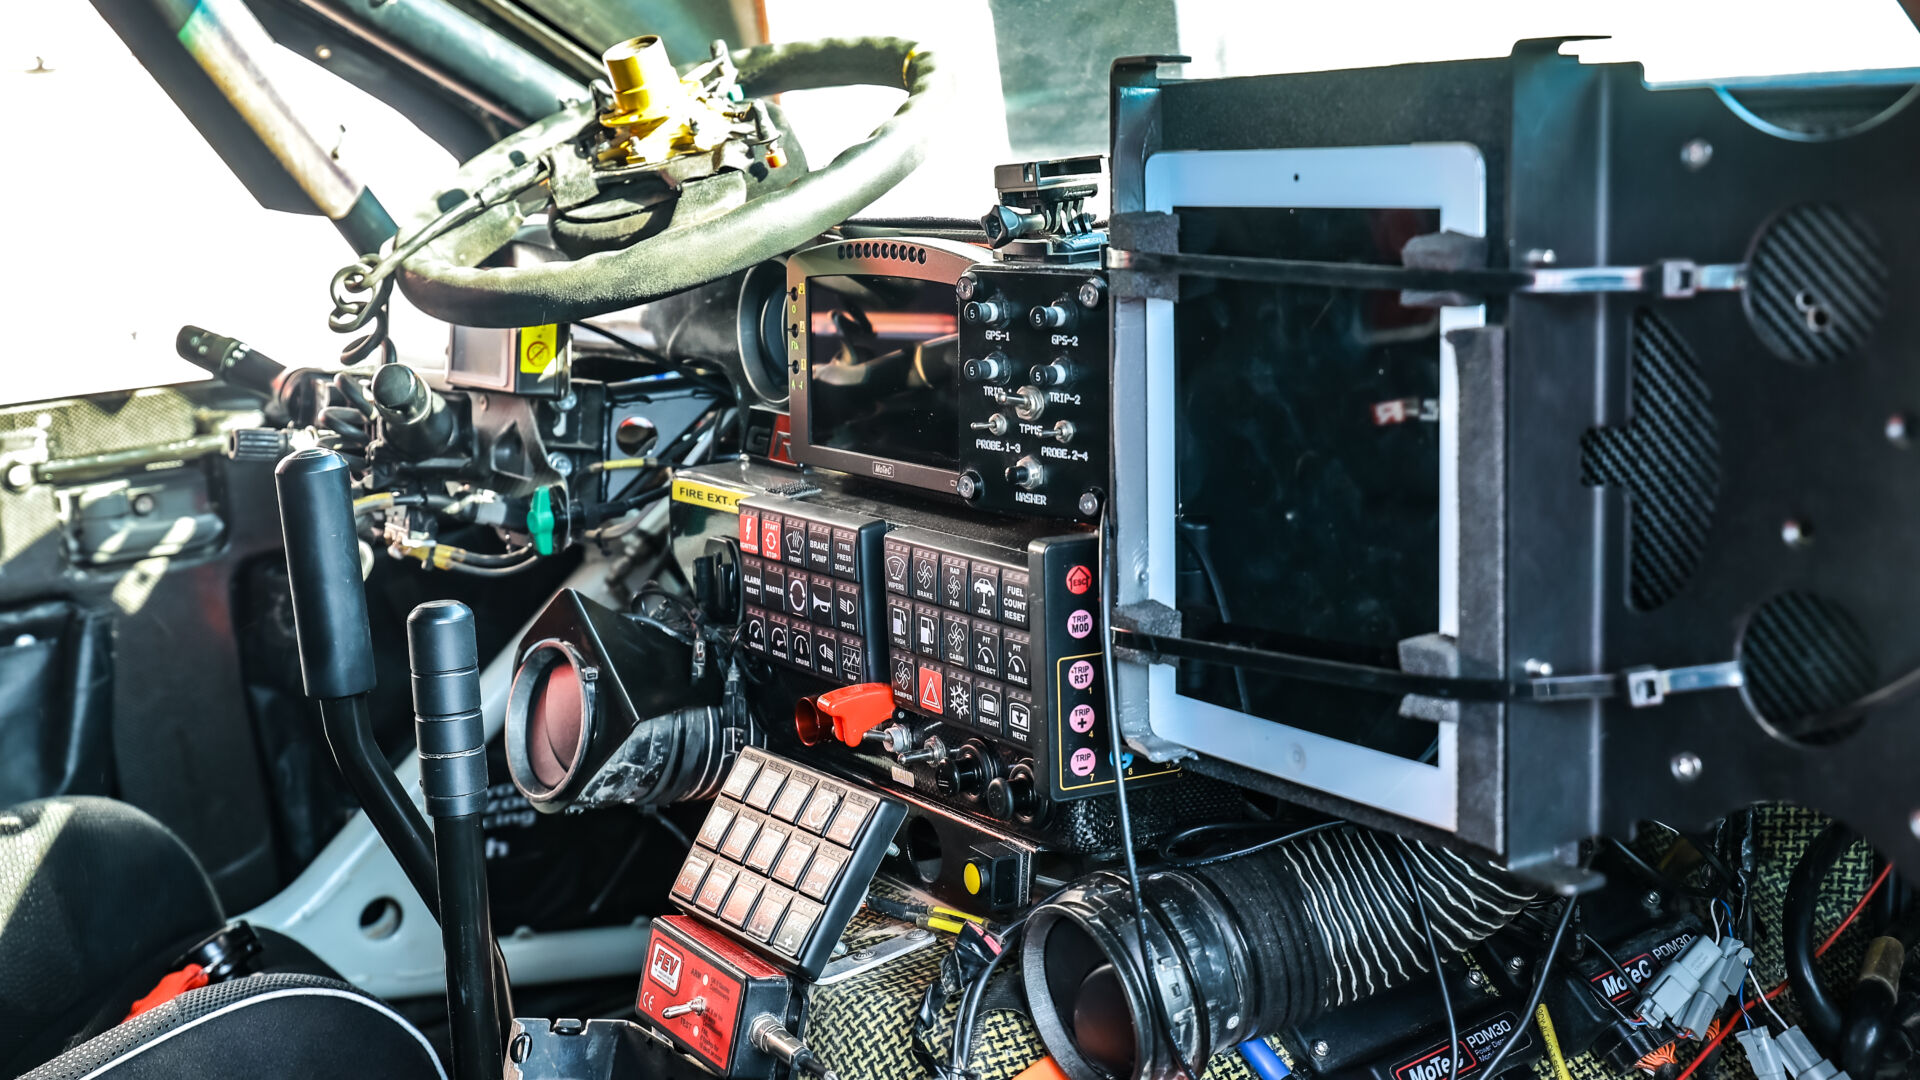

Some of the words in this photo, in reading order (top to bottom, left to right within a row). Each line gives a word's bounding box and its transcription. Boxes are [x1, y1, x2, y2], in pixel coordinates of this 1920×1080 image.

[970, 310, 975, 318] 5
[1036, 314, 1040, 323] 5
[986, 330, 1010, 341] GPS-1
[1052, 335, 1078, 346] GPS-2
[970, 367, 975, 375] 5
[1036, 372, 1040, 381] 5
[1050, 392, 1080, 405] TRIP-2
[976, 439, 1021, 453] PROBE.1-3
[1041, 447, 1088, 462] PROBE.2-4
[875, 463, 892, 475] MoTeC
[680, 487, 704, 500] FIRE
[707, 493, 731, 506] EXT.
[1016, 492, 1047, 505] WASHER
[765, 523, 778, 531] START
[740, 542, 758, 551] IGNITION
[810, 540, 828, 551] BRAKE
[839, 543, 850, 551] TYRE
[812, 553, 827, 563] PUMP
[837, 554, 851, 562] PRESS
[835, 564, 854, 574] DISPLAY
[950, 567, 960, 575] RAD
[744, 575, 760, 585] ALARM
[746, 587, 759, 595] RESET
[766, 585, 784, 595] MASTER
[888, 582, 904, 591] WIPERS
[1007, 586, 1024, 597] FUEL
[917, 590, 933, 600] BRAKE
[950, 600, 959, 608] FAN
[1004, 598, 1026, 611] COUNT
[978, 607, 991, 616] JACK
[1005, 610, 1025, 622] RESET
[1072, 615, 1088, 623] TRIP
[841, 621, 855, 630] SPOTS
[1072, 623, 1089, 634] MOD
[982, 636, 990, 644] PIT
[750, 642, 764, 651] CRUISE
[923, 646, 933, 655] LIFT
[1013, 644, 1021, 652] PIT
[773, 650, 787, 659] CRUISE
[949, 652, 964, 662] CABIN
[796, 658, 810, 667] CRUISE
[821, 665, 833, 673] REAR
[977, 664, 996, 676] SELECT
[1073, 666, 1089, 674] TRIP
[1008, 674, 1028, 685] ENABLE
[1074, 674, 1089, 684] RST
[894, 690, 912, 701] DAMPER
[1075, 708, 1090, 716] TRIP
[980, 716, 999, 728] BRIGHT
[1013, 731, 1027, 742] NEXT
[1089, 730, 1094, 738] 4
[1076, 753, 1091, 762] TRIP
[1090, 773, 1094, 781] 7
[1652, 934, 1692, 960] PDM30
[655, 948, 679, 976] FEV
[1466, 1020, 1511, 1048] PDM30
